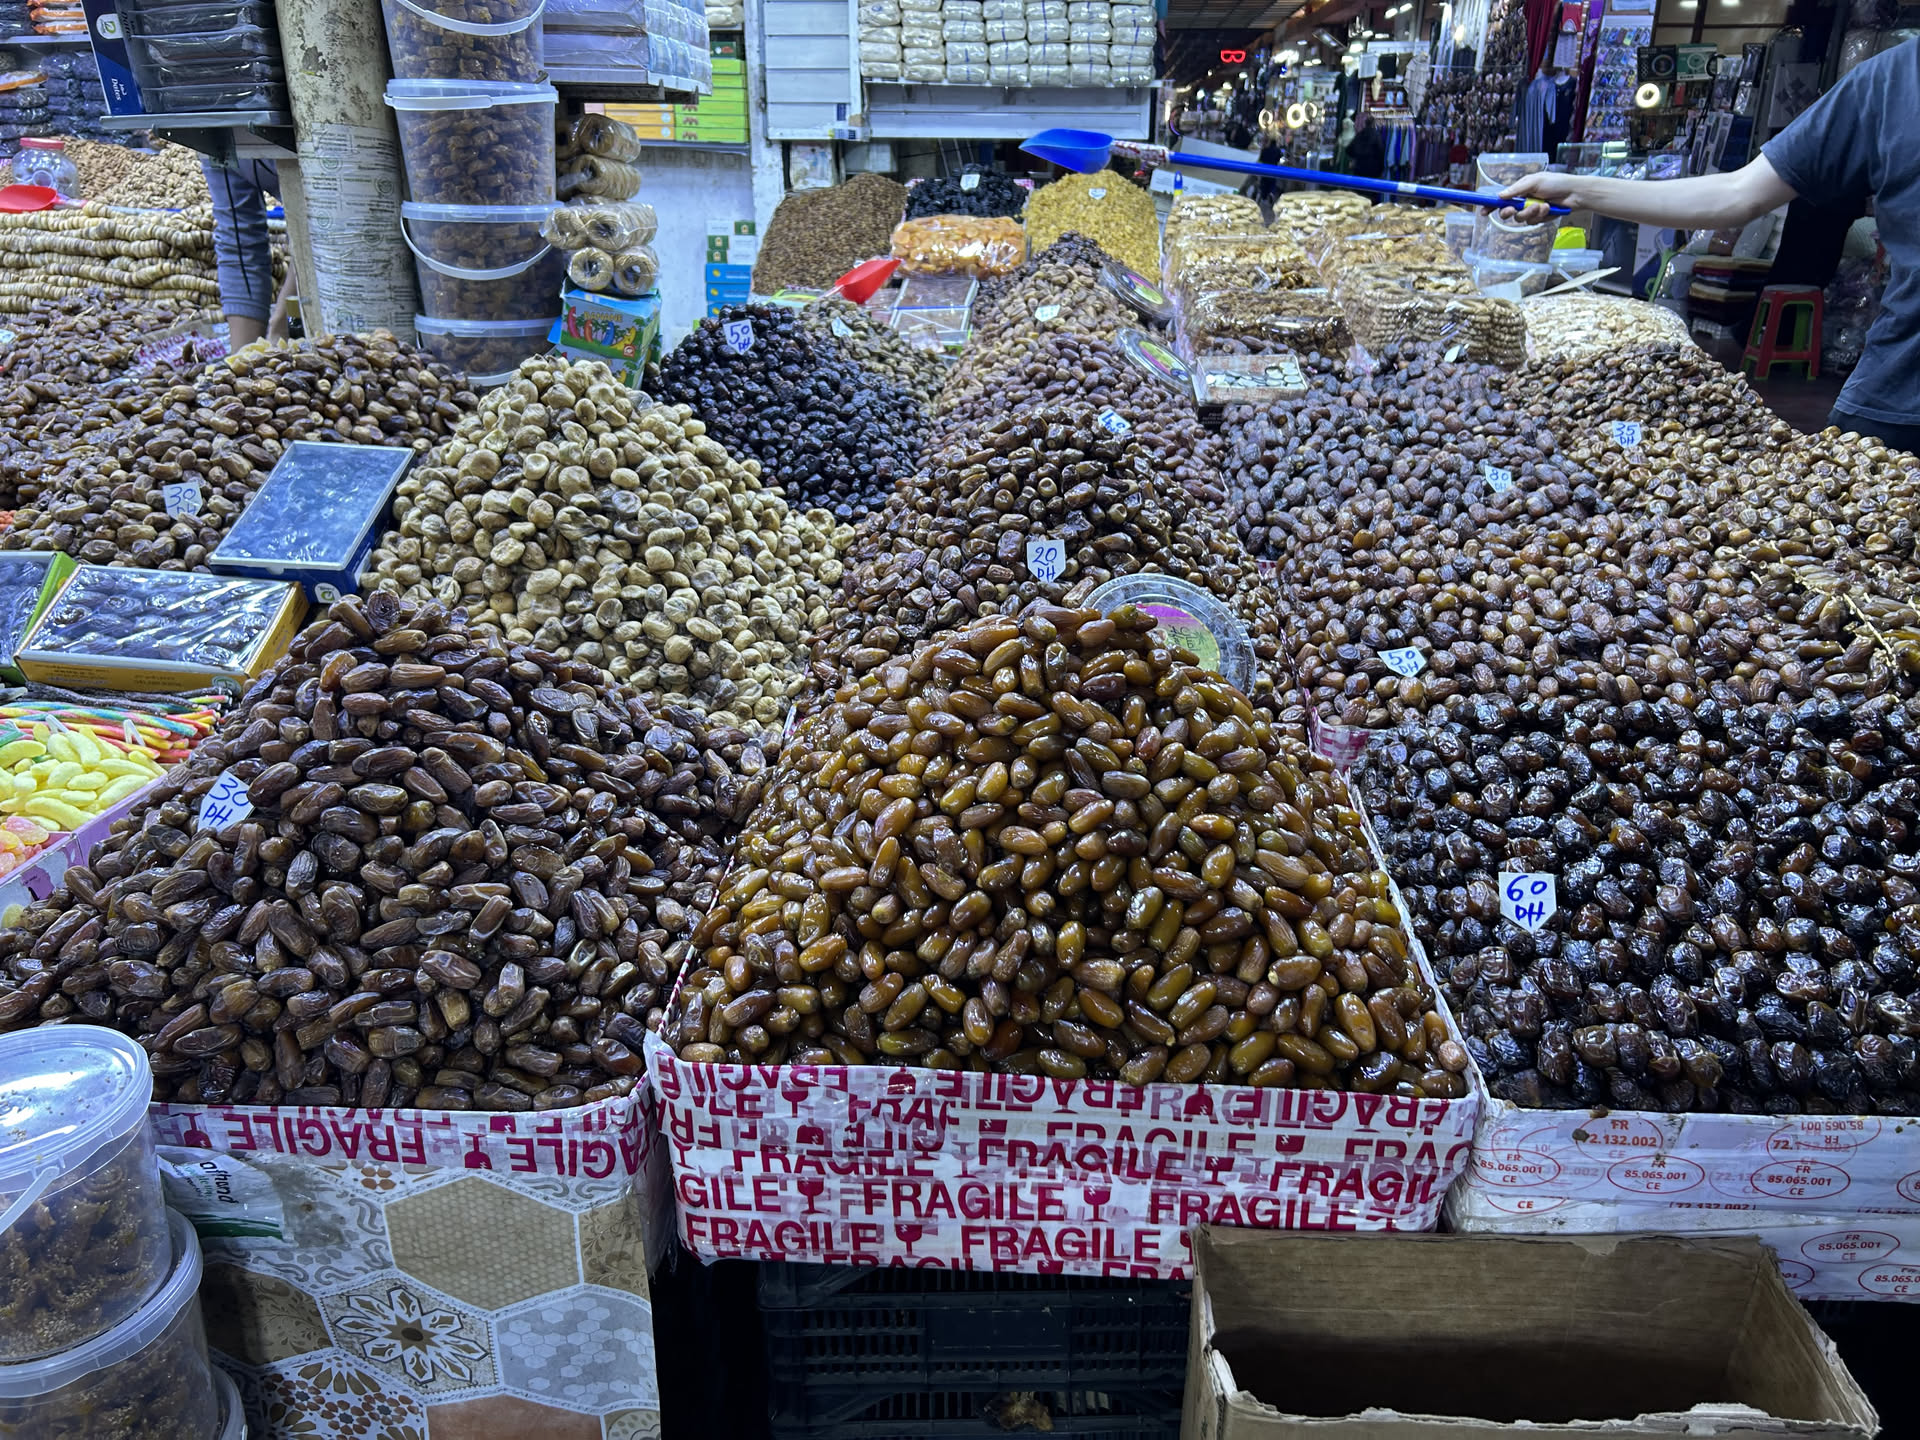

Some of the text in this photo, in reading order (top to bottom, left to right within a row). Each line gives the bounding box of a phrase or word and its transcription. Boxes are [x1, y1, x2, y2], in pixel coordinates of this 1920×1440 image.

[111, 78, 122, 101] Dates
[583, 311, 623, 323] BANANE
[729, 324, 750, 345] 50
[1614, 422, 1638, 437] 35
[1620, 435, 1634, 446] DH
[1490, 468, 1508, 480] 80
[168, 486, 197, 508] 30
[1032, 546, 1057, 566] 20
[1037, 565, 1056, 582] DH
[1388, 650, 1416, 666] 50
[208, 777, 250, 807] 30
[1506, 874, 1548, 902] 60
[1515, 900, 1546, 928] DH
[1611, 1119, 1629, 1130] FR
[223, 1113, 428, 1165] FRAGILE
[1587, 1133, 1657, 1148] 2.132.002
[978, 1138, 1187, 1182] FRAGILE
[1506, 1153, 1521, 1162] FR
[1480, 1159, 1542, 1174] 85.065.001
[1502, 1174, 1517, 1183] CE
[1624, 1170, 1687, 1180] 85.065.001
[1768, 1175, 1832, 1186] 85.065.001
[1646, 1182, 1661, 1190] CE
[1789, 1187, 1805, 1196] CE
[863, 1178, 1065, 1222] FRAGILE
[1517, 1200, 1534, 1209] CE
[1150, 1188, 1356, 1231] FRAGILE
[685, 1213, 877, 1254] FRAGILE
[961, 1224, 1162, 1265] FRAGILE
[1818, 1241, 1881, 1251] 85.065.001
[1841, 1252, 1857, 1261] CE
[1894, 1285, 1908, 1293] CE
